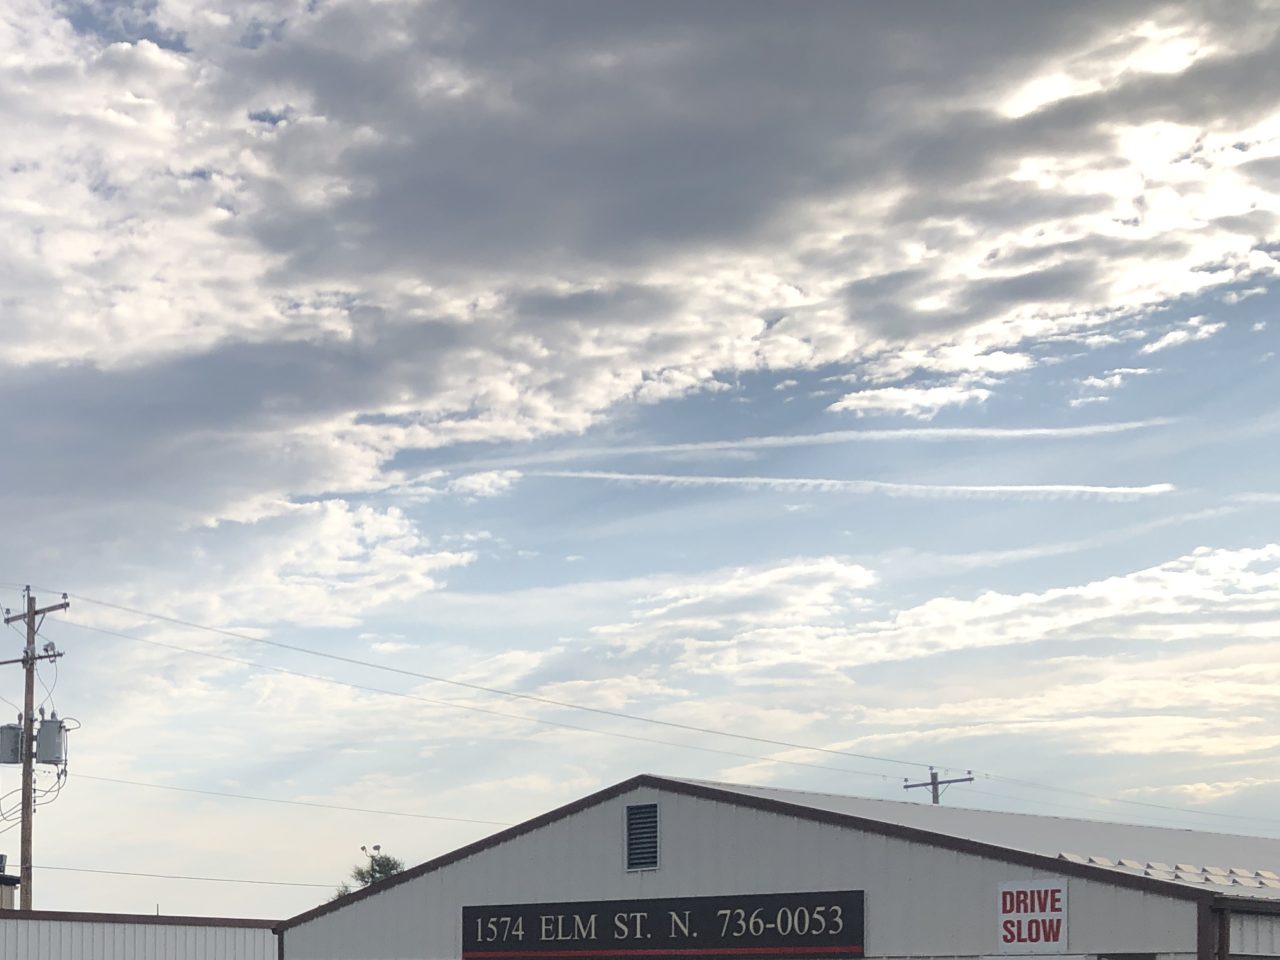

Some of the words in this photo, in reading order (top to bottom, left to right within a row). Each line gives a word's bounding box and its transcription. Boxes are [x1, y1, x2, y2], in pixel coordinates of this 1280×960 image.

[1001, 889, 1062, 914] DRIVE
[475, 916, 525, 942] 1574
[539, 914, 598, 941] ELM
[613, 912, 652, 940] ST.
[668, 911, 698, 938] N.
[717, 906, 844, 937] 736-0053
[1002, 918, 1062, 943] SLOW
